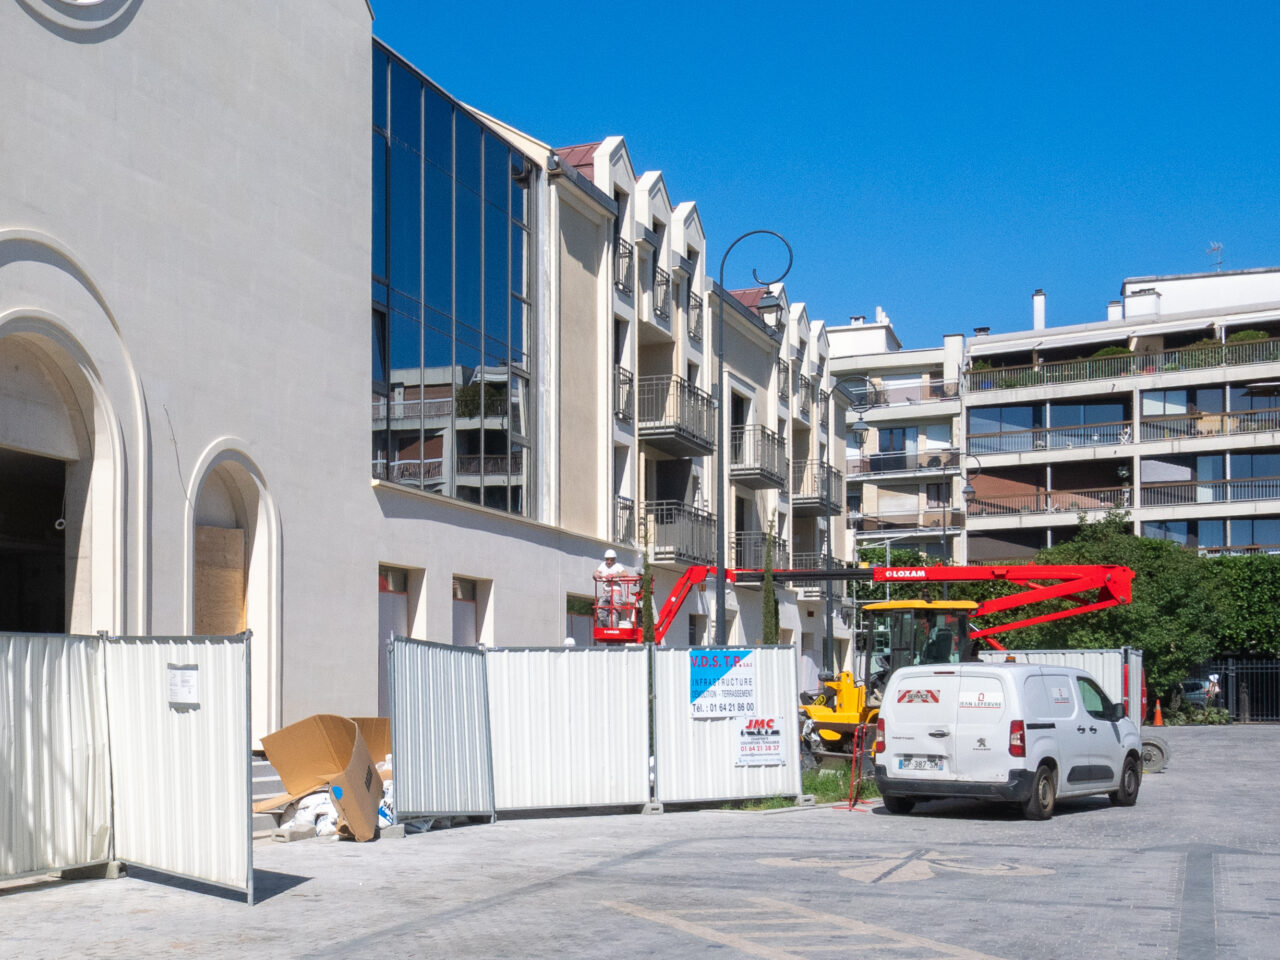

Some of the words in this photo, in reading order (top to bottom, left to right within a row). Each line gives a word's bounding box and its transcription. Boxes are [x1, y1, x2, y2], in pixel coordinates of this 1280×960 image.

[690, 655, 722, 668] V.D.S.
[724, 655, 742, 668] T.P.
[692, 677, 753, 687] INFRASTRUCTURE
[722, 689, 753, 698] TERRASSEMENT
[710, 703, 717, 712] 01
[719, 703, 727, 712] 64
[728, 703, 736, 712] 21
[746, 702, 755, 712] 00
[745, 718, 775, 730] JMC
